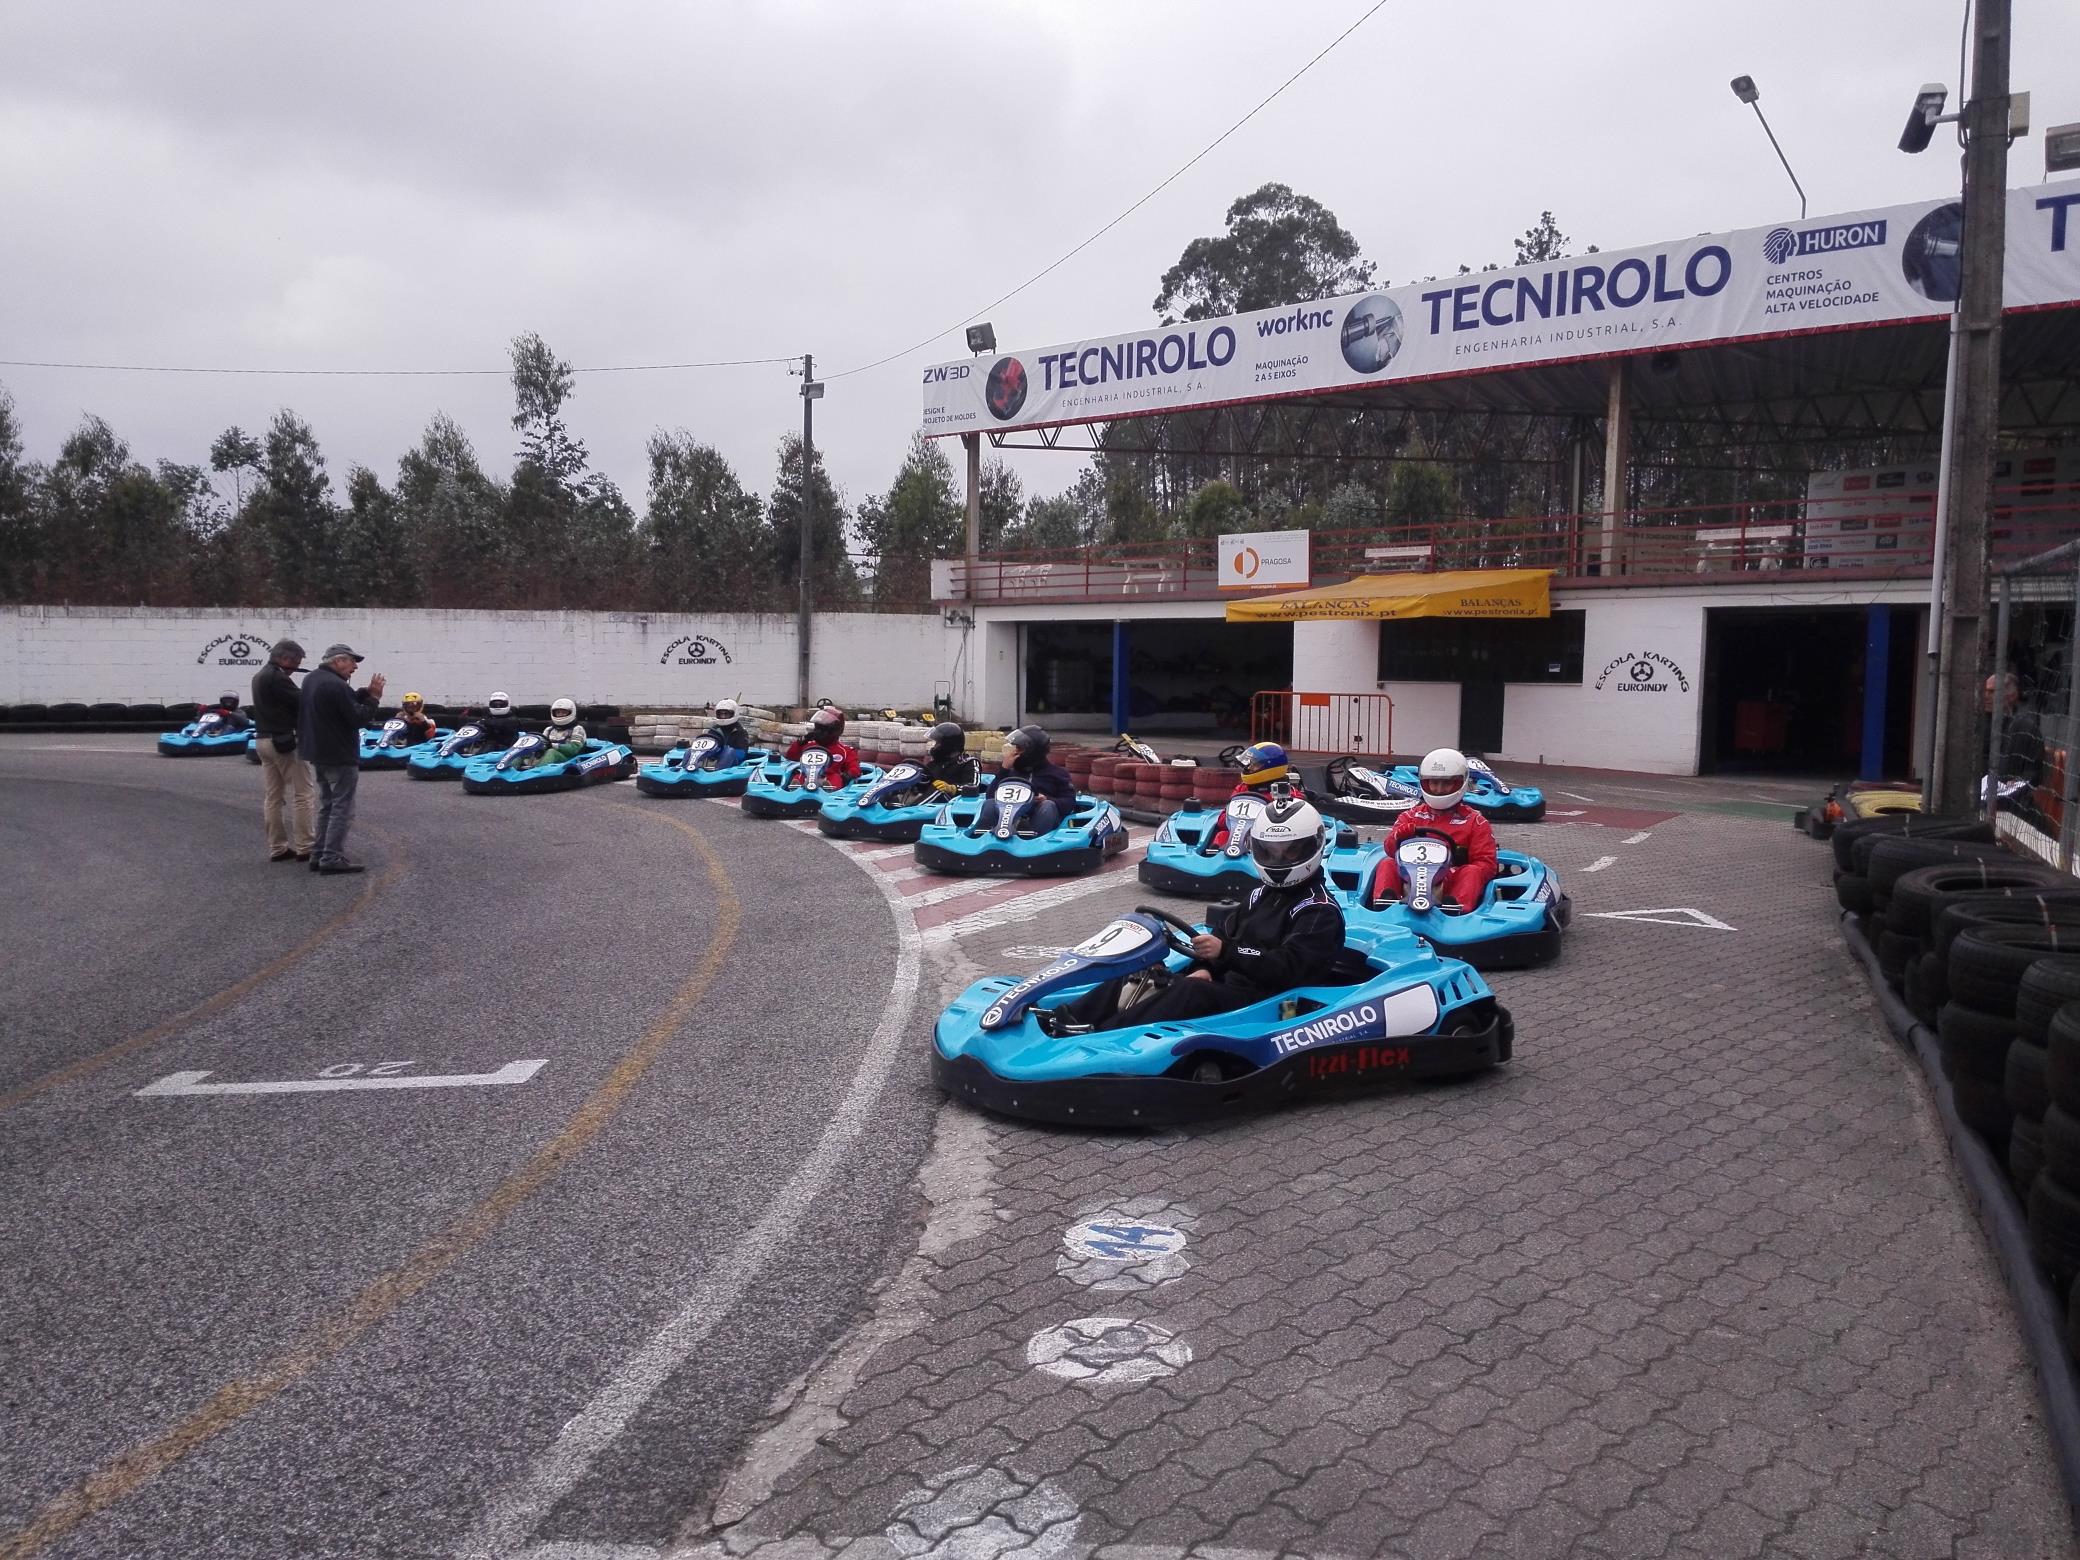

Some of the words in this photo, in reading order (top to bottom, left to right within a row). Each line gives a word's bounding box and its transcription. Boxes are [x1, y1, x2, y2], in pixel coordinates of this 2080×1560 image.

[1805, 224, 1880, 252] HURON
[1766, 269, 1823, 286] CENTROS
[1421, 244, 1732, 336] TECNIROLO
[1766, 278, 1852, 300] MAQUINAÇÃO
[1764, 301, 1796, 315] ALTA
[1799, 291, 1880, 311] VELOCIDADE
[1256, 308, 1334, 337] worknc
[1455, 334, 1542, 355] ENGENHARIA
[1549, 320, 1644, 342] INDUSTRIAL,
[1038, 326, 1237, 391] TECNIROLO
[1255, 355, 1309, 371] MAQUINAÇÃO
[923, 365, 970, 383] ZW3D
[1255, 373, 1261, 382] 2
[1260, 373, 1267, 381] A
[1267, 372, 1273, 381] 5
[1274, 369, 1297, 380] EIXOS
[1062, 393, 1119, 407] ENGENHARIA
[954, 412, 977, 422] MOLDES
[1261, 557, 1292, 567] PRAGOSA
[1461, 598, 1521, 608] BALANÇAS
[197, 634, 233, 664] ESCOLA
[240, 633, 274, 653] KARTI
[660, 635, 691, 665] ESCOLA
[696, 634, 732, 664] KARTING
[678, 657, 717, 665] EUROINDY
[1595, 652, 1636, 691] ESCOLA
[1643, 651, 1690, 693] KARTING
[1617, 682, 1668, 692] EUROINDY
[387, 721, 402, 729] 27
[695, 740, 708, 749] 30
[807, 753, 824, 763] 25
[889, 768, 906, 778] 32
[1003, 788, 1022, 801] 31
[1388, 780, 1419, 796] TECNIROLO
[1237, 802, 1250, 816] 11
[1416, 846, 1428, 862] 3
[998, 958, 1078, 1006] TECNIROLO
[1271, 1005, 1377, 1054] TECNIROLO
